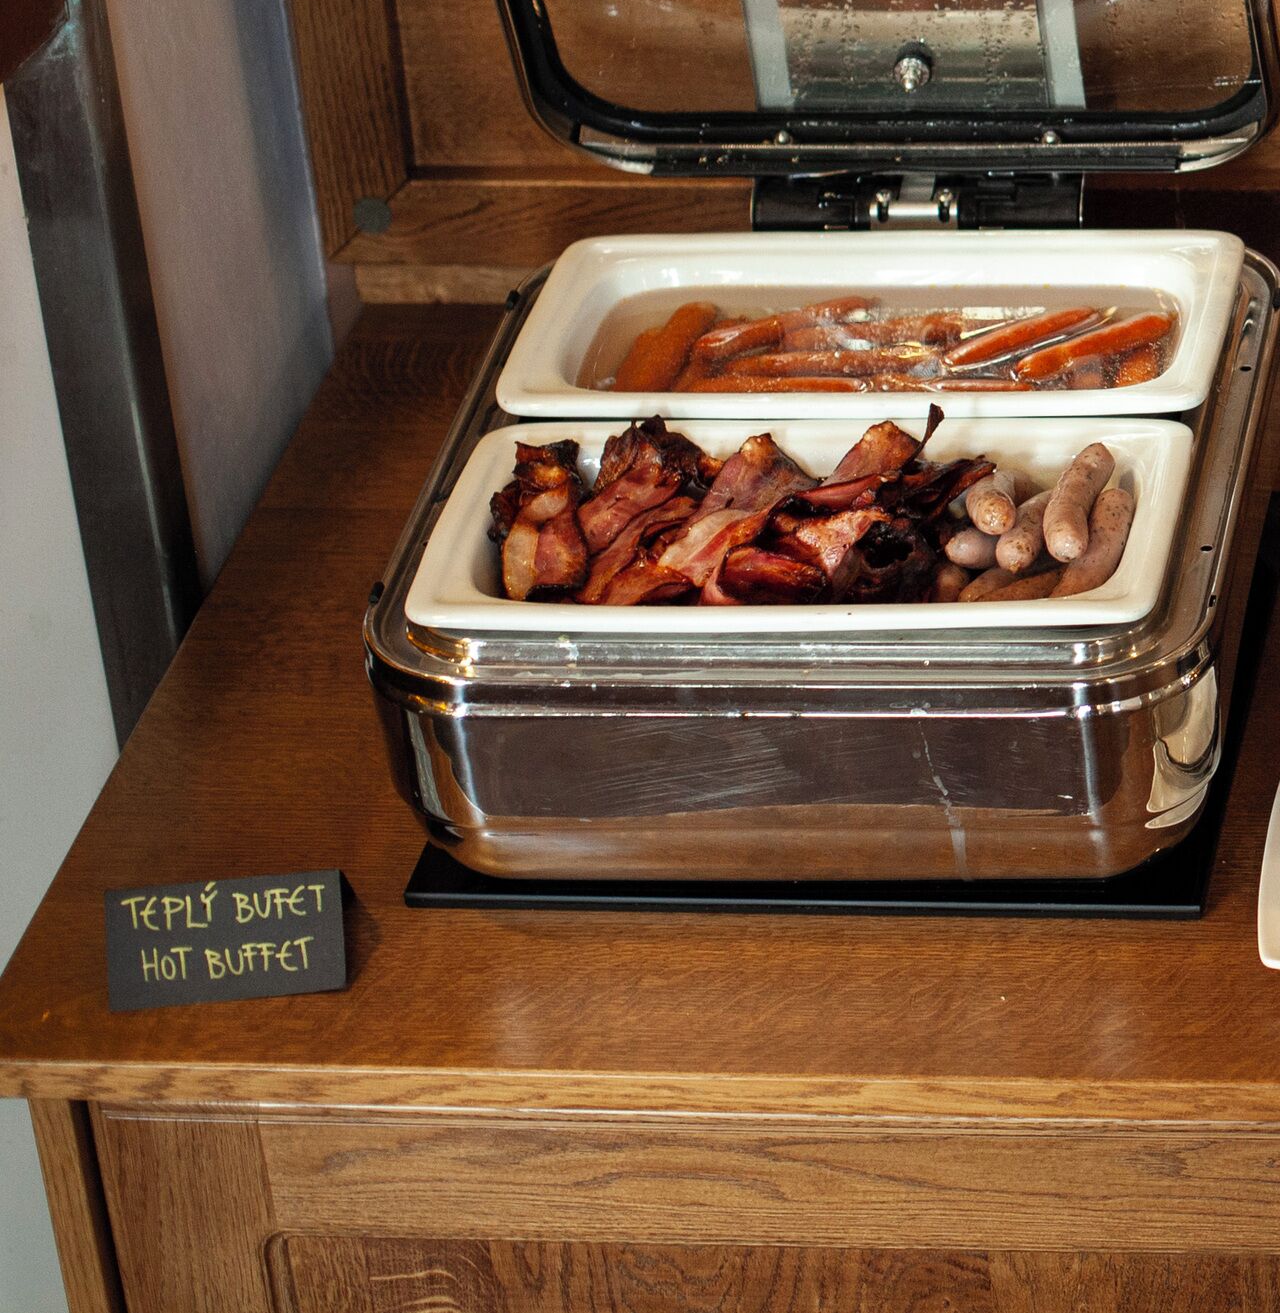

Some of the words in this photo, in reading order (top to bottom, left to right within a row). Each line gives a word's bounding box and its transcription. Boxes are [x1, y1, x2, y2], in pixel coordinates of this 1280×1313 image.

[121, 881, 217, 930] TEPLÝ
[232, 885, 325, 923] BUFET
[141, 946, 193, 981] HOT
[204, 936, 314, 979] BUFFET
